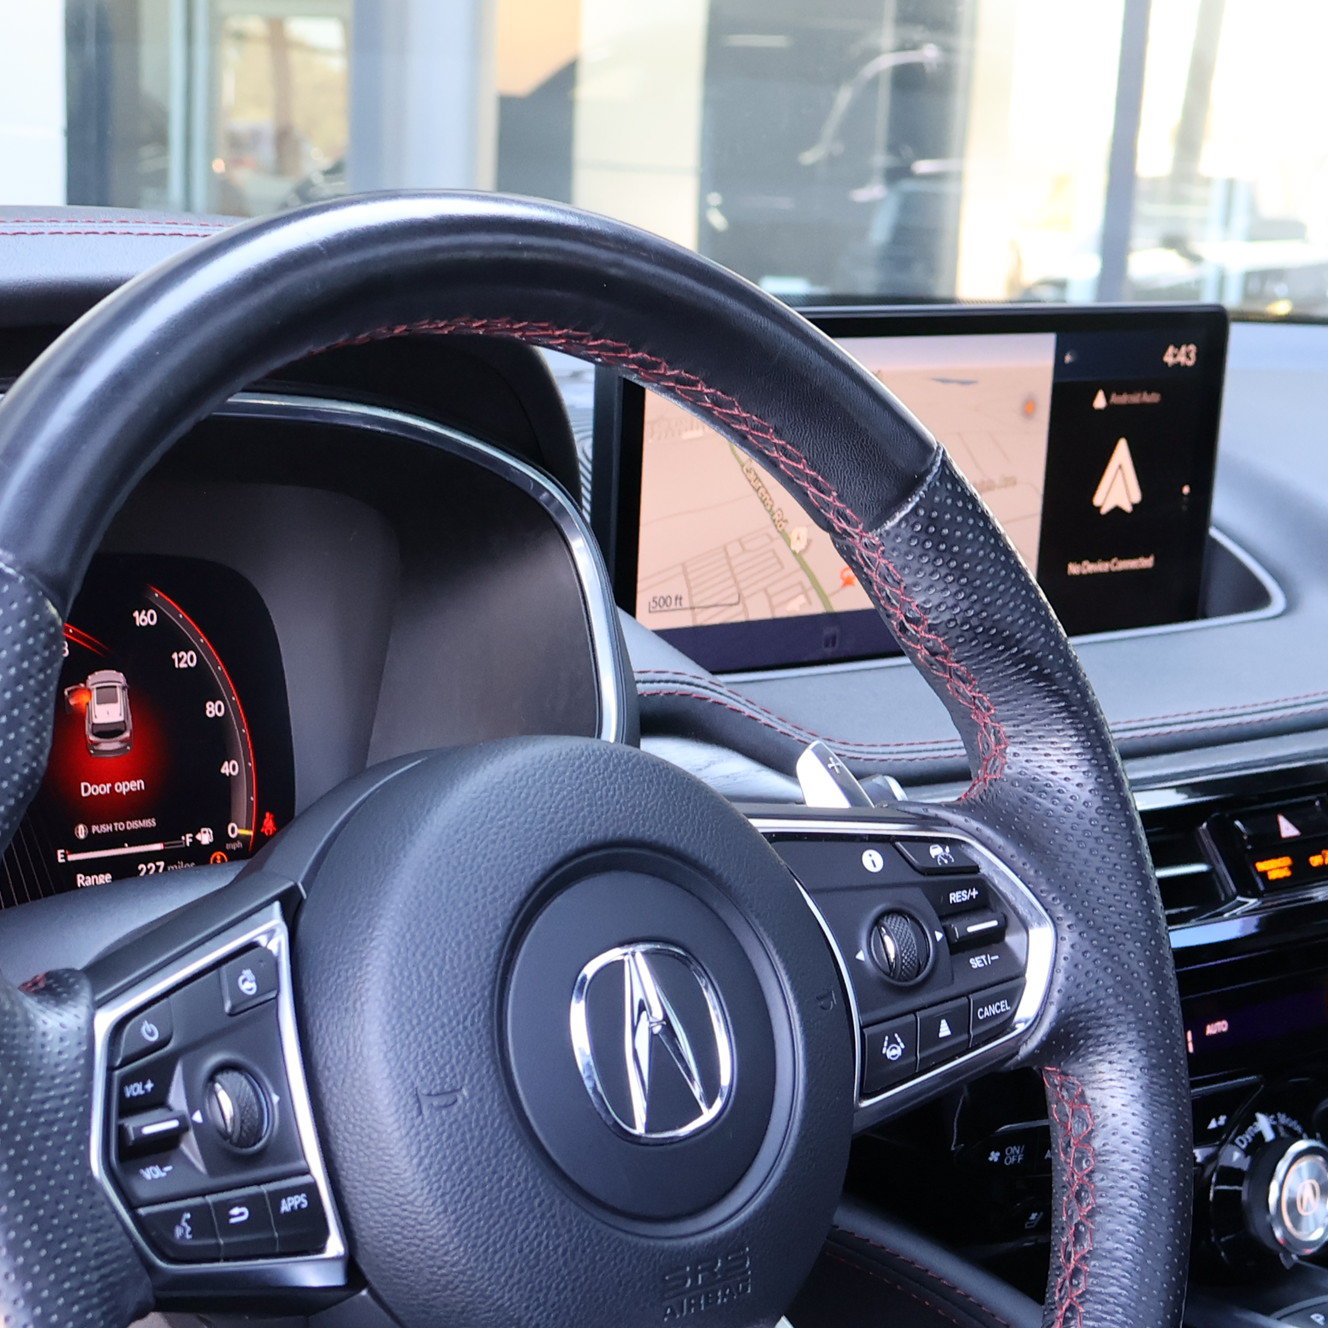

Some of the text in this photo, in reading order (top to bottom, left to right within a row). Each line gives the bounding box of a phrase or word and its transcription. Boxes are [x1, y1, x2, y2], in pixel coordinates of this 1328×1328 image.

[652, 595, 683, 608] 500 ft
[133, 609, 157, 627] 160
[172, 650, 197, 668] 120
[206, 701, 225, 718] 80
[220, 760, 239, 777] 40
[81, 778, 145, 797] Door open
[92, 818, 157, 835] PUSH TO DISMISS
[227, 823, 238, 838] 0
[186, 833, 194, 847] F
[225, 841, 243, 851] mph
[56, 849, 66, 863] E
[76, 872, 113, 888] Range
[949, 888, 979, 904] RES/+
[977, 998, 1011, 1021] CANCEL
[1205, 1020, 1228, 1036] AUTO
[124, 1078, 154, 1099] VOL+
[1004, 1154, 1024, 1166] OFF
[280, 1193, 308, 1215] APPS
[664, 1246, 751, 1290] SRS
[662, 1270, 752, 1323] AIRBAG
